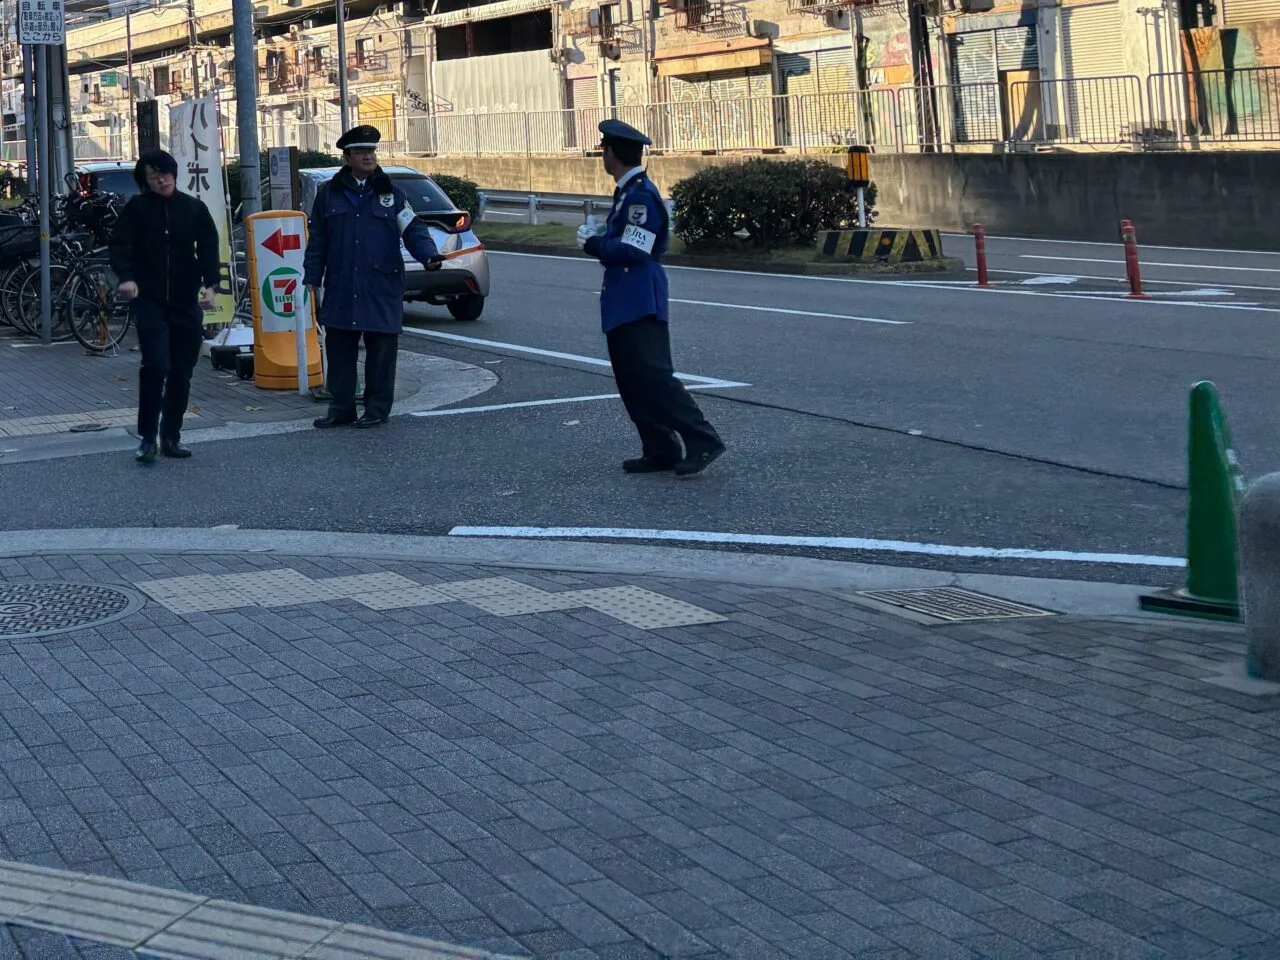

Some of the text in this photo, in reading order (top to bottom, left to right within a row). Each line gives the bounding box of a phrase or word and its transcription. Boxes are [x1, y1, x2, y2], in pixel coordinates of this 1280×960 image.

[22, 32, 61, 41] ここから
[631, 227, 646, 242] JRA
[275, 295, 295, 303] ELEVE
